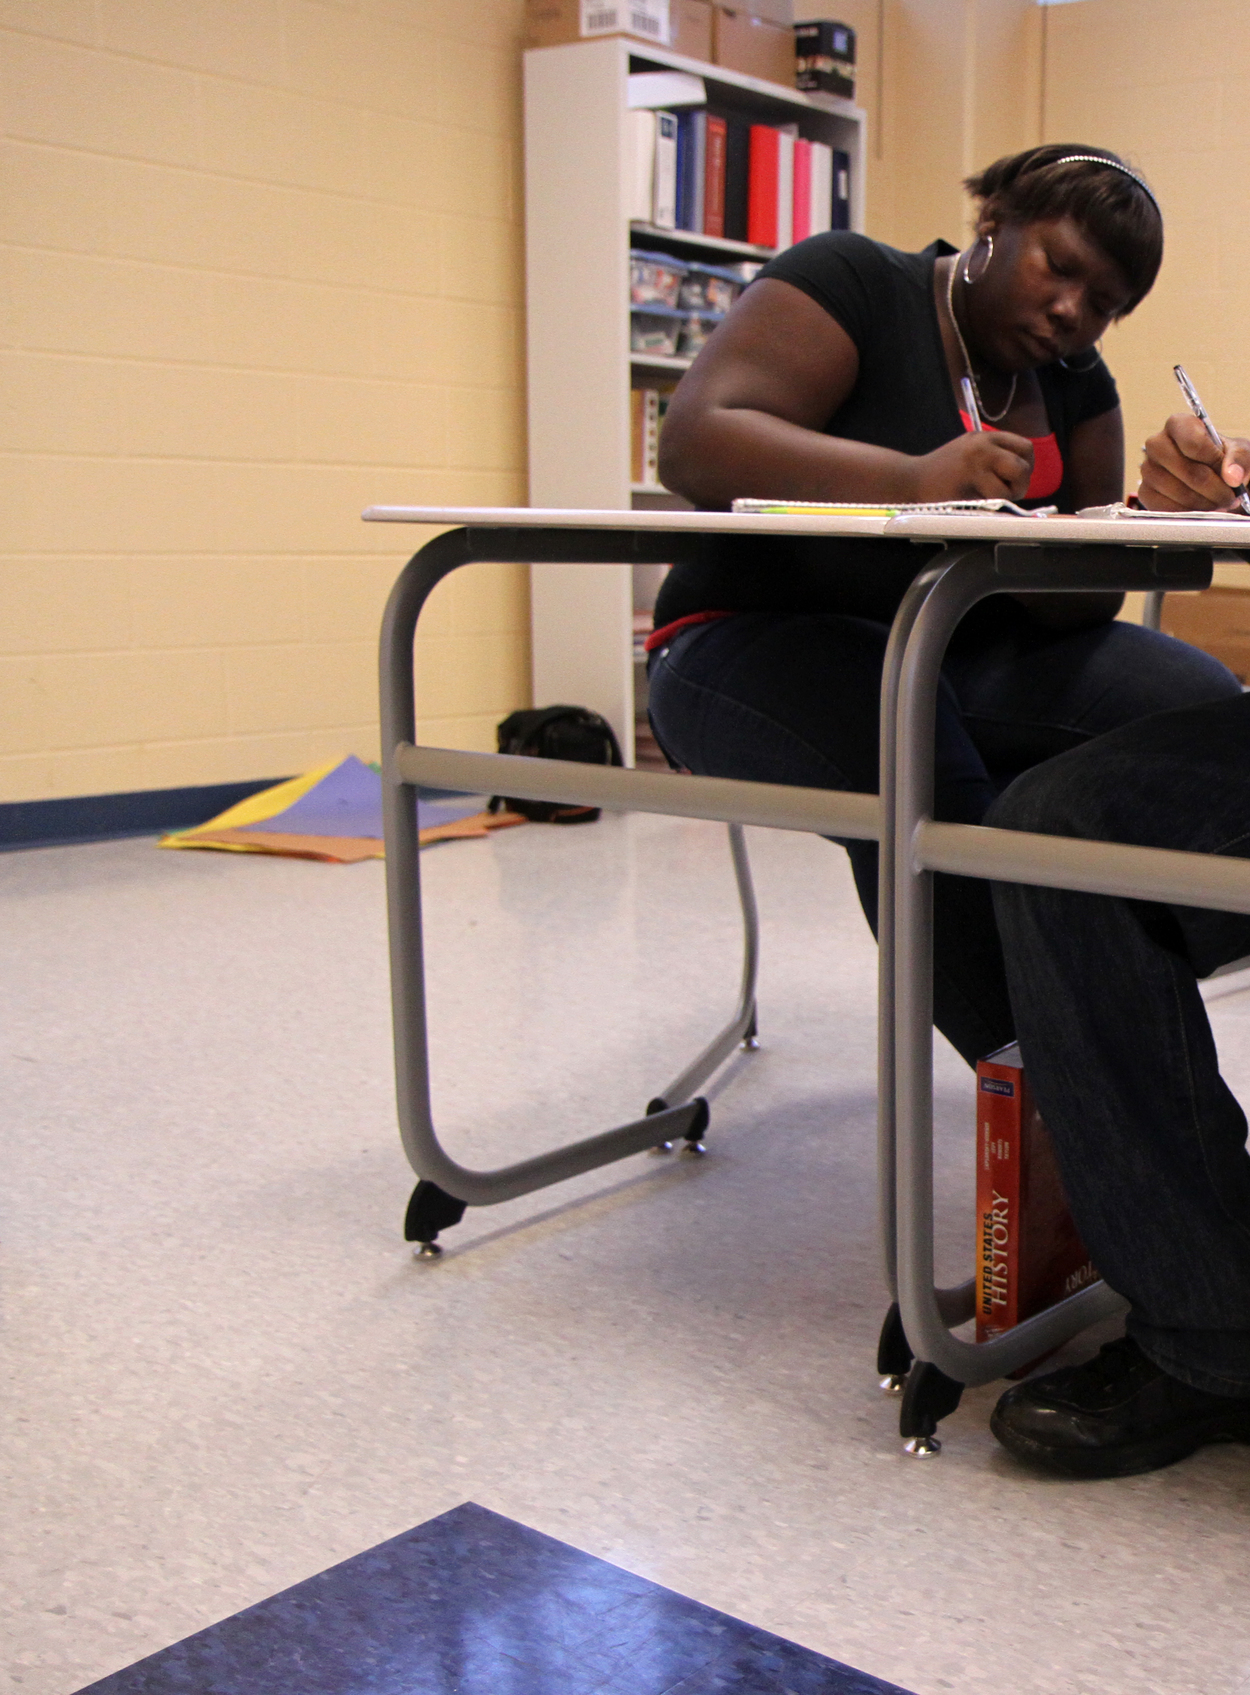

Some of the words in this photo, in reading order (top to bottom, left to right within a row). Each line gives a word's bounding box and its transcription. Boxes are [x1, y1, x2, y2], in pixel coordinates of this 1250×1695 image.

[983, 1082, 1011, 1094] PEARSON
[983, 1212, 994, 1263] STATES
[991, 1189, 1010, 1306] HISTORY
[982, 1266, 993, 1315] UNITED
